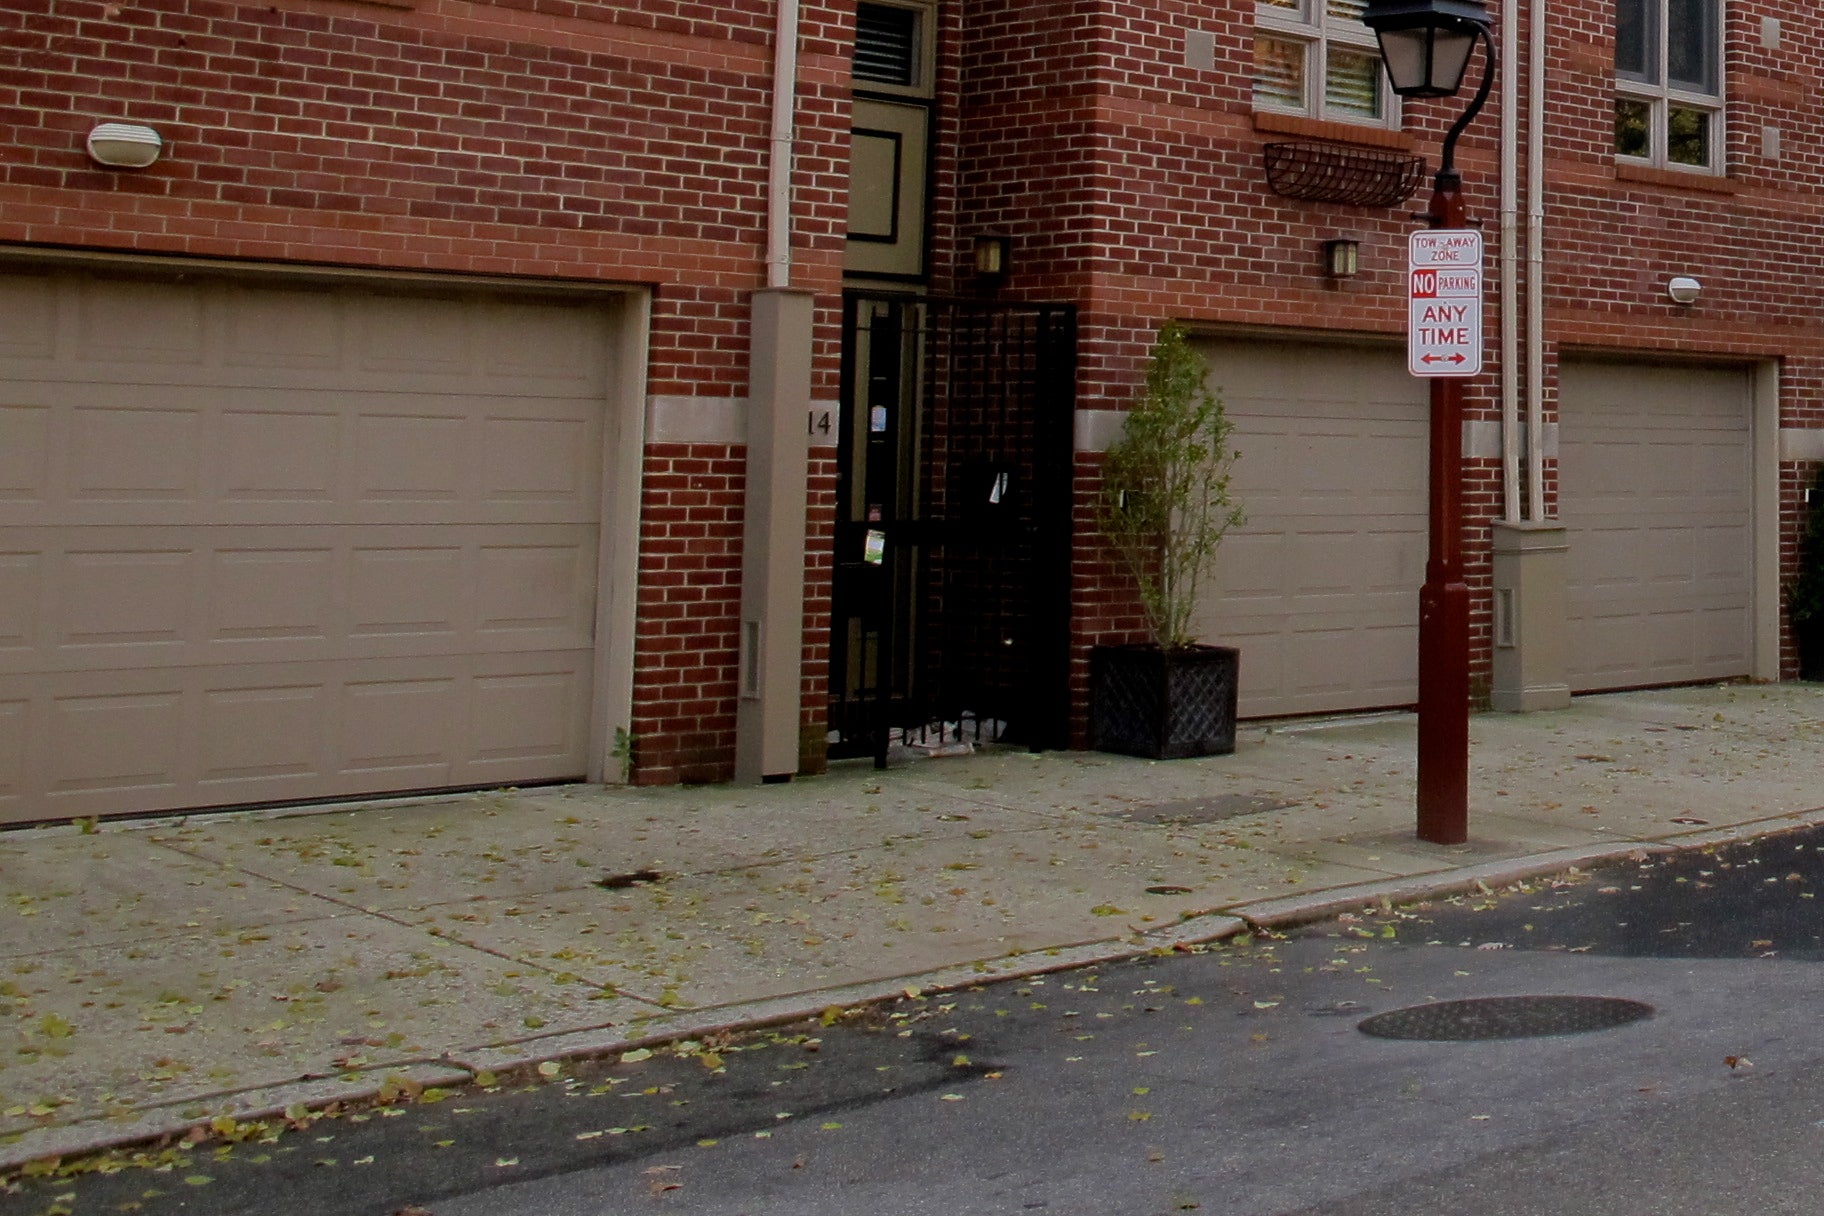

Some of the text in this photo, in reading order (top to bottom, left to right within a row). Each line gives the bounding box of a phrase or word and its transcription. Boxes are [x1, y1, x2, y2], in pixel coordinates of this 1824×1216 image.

[1431, 250, 1459, 261] ZONE
[1413, 273, 1476, 294] NO PARKING
[1422, 305, 1468, 323] ANY
[1418, 327, 1470, 345] TIME
